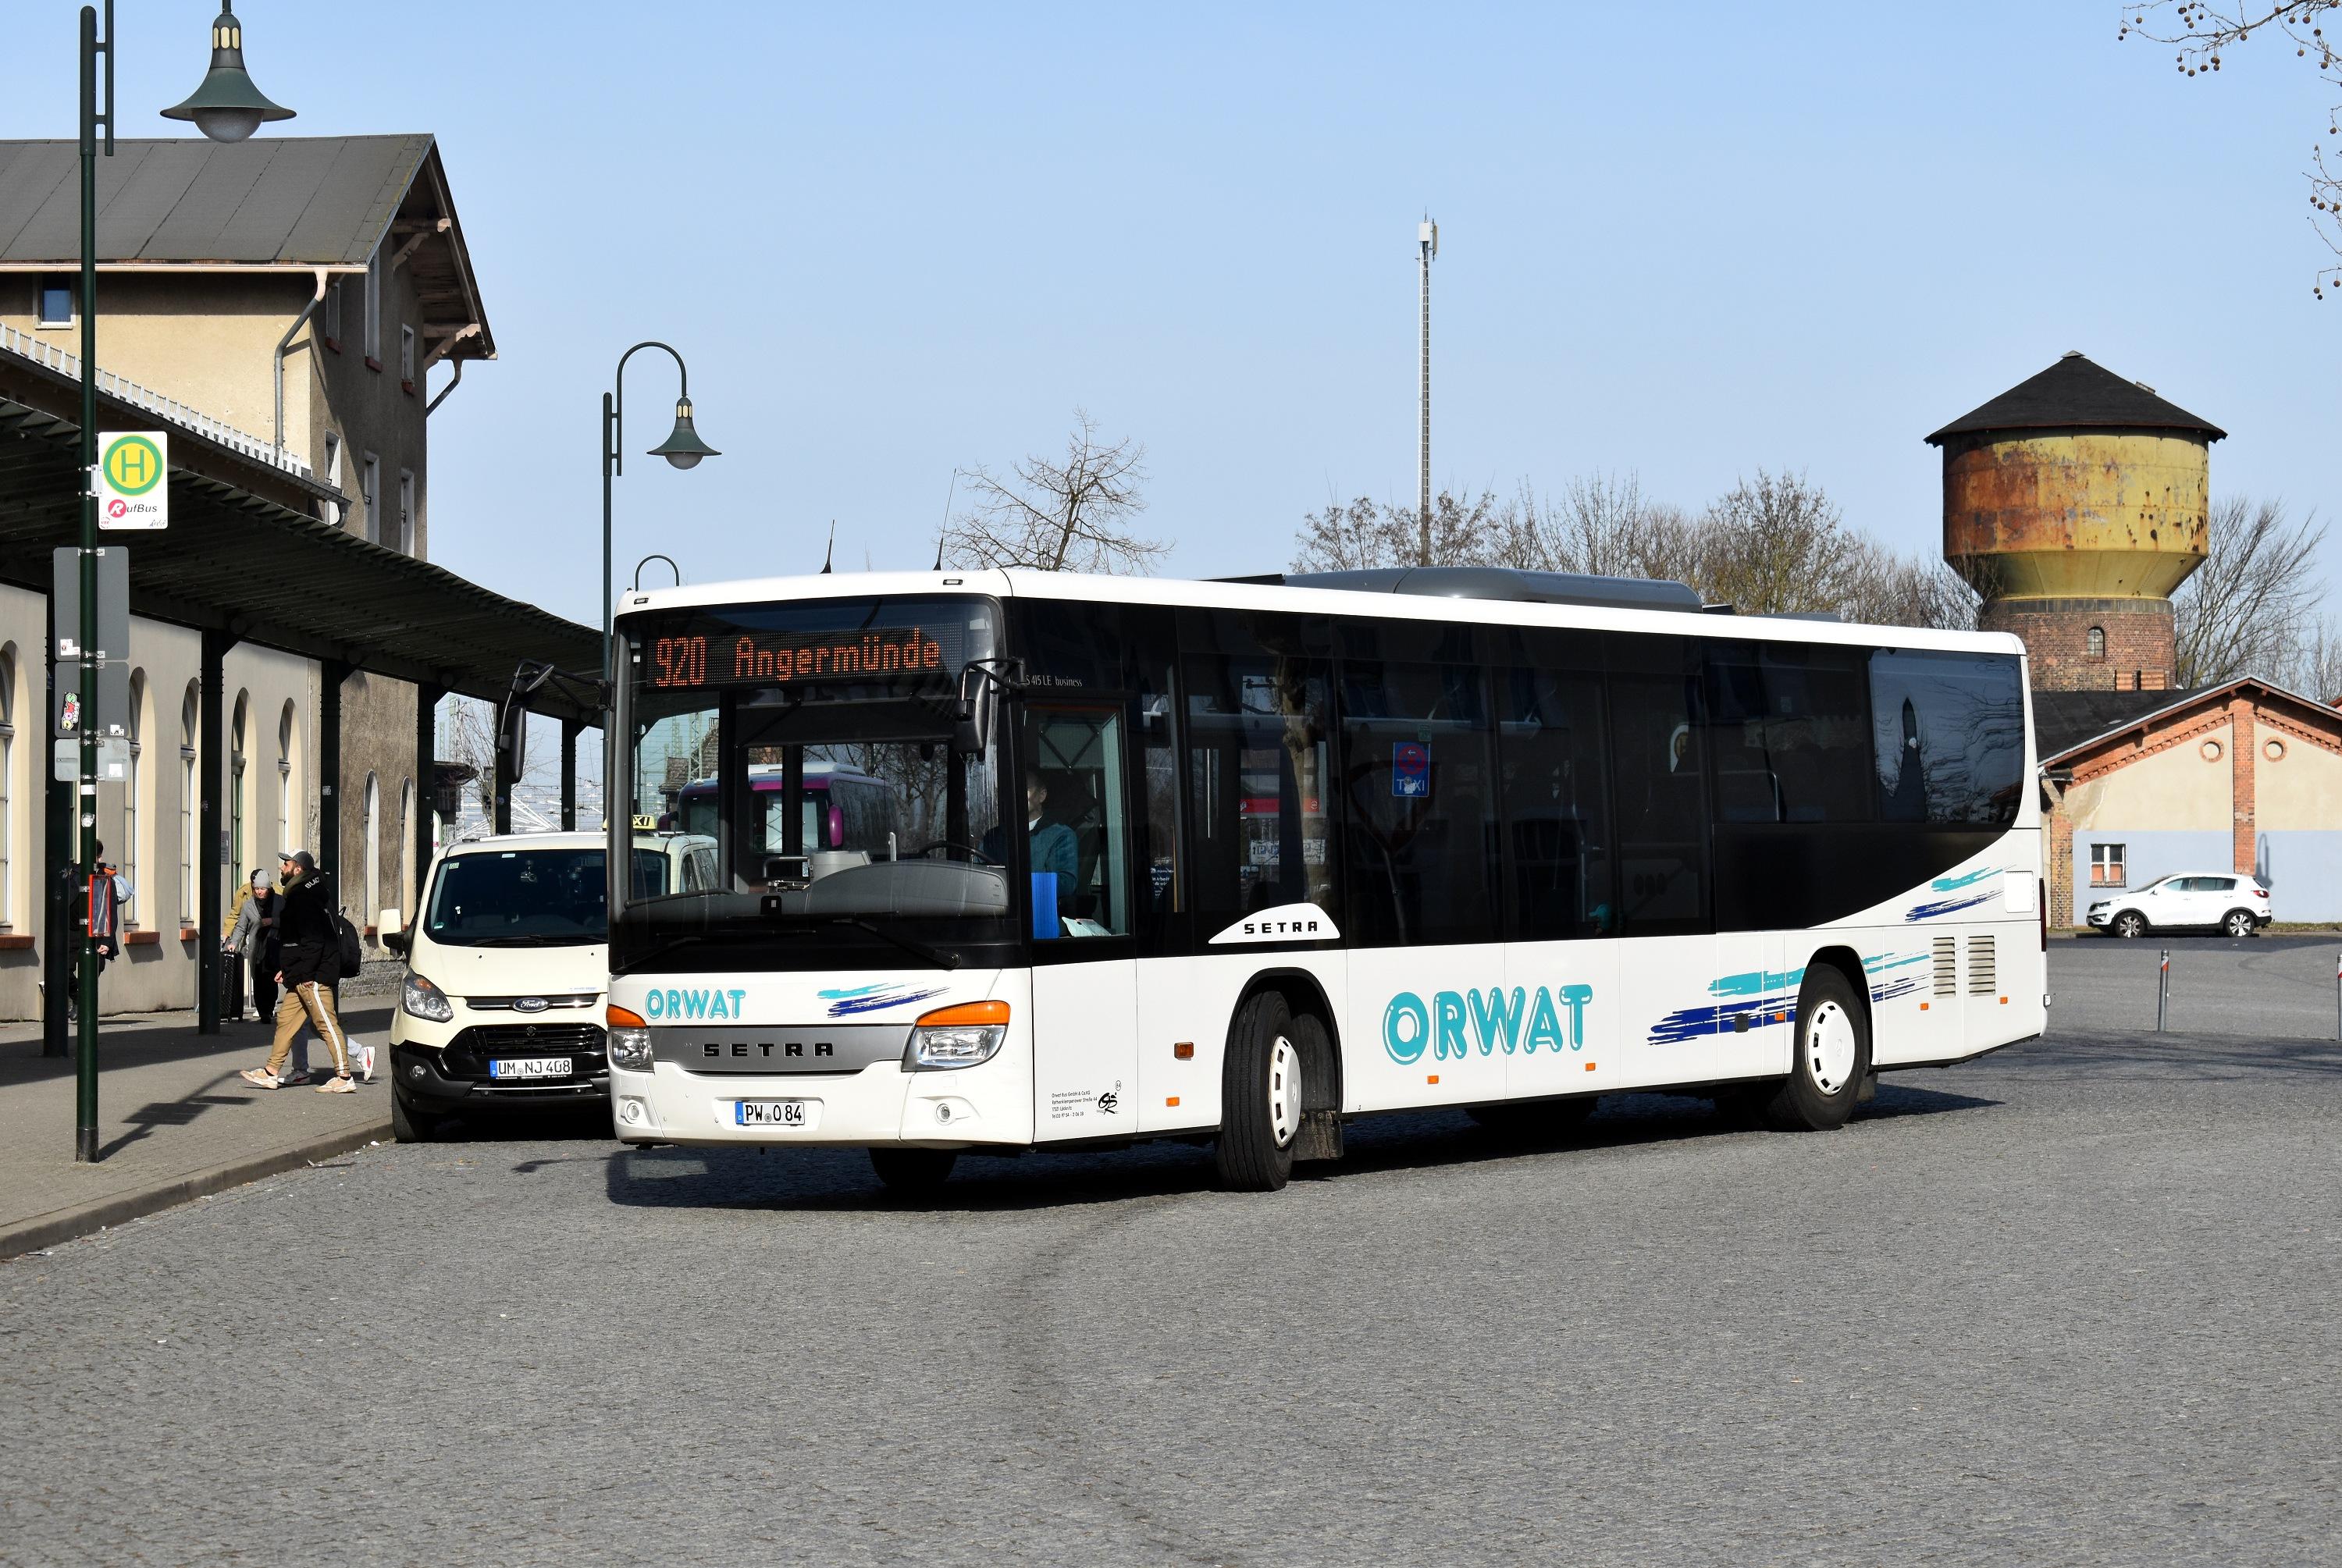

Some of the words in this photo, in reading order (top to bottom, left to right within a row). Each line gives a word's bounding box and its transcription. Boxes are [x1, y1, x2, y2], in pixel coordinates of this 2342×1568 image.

[121, 449, 145, 482] H
[109, 502, 158, 515] RufBus
[656, 636, 706, 687] 920
[735, 625, 940, 681] Angermünde
[1055, 675, 1083, 687] business
[1397, 779, 1425, 791] TXI
[1244, 921, 1318, 934] SETRA
[646, 989, 746, 1019] ORWAT
[1382, 983, 1593, 1065] ORWAT
[703, 1043, 834, 1057] SETRA
[498, 1062, 516, 1075] UM
[525, 1061, 543, 1074] NJ
[546, 1060, 571, 1073] 408
[745, 1104, 763, 1122] PW
[785, 1104, 803, 1122] 84
